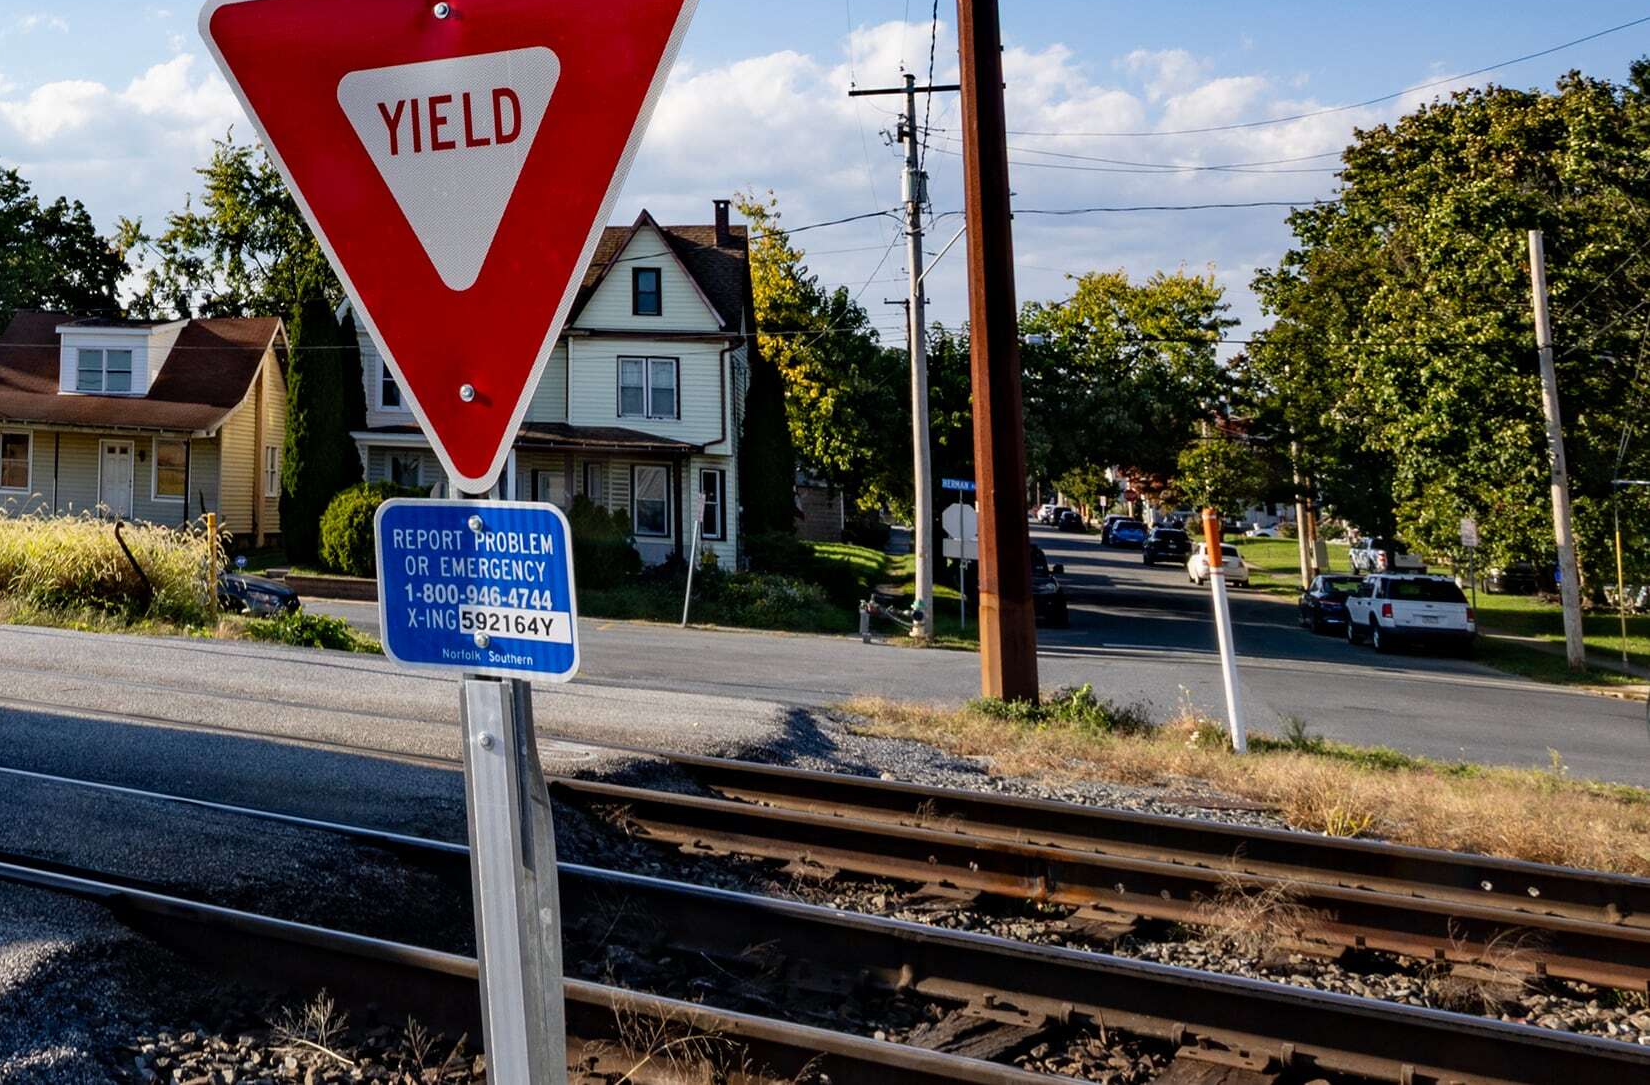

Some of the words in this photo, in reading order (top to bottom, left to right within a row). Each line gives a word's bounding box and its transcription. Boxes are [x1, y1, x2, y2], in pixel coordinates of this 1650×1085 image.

[377, 87, 522, 156] YIELD
[394, 529, 462, 550] REPORT
[474, 531, 554, 555] PROBLEM
[405, 555, 429, 576] OR
[441, 557, 545, 582] EMERGENCY
[405, 583, 552, 610] 1-800-946-4744
[408, 608, 456, 629] X-ING
[461, 611, 554, 636] 592164Y
[442, 648, 482, 661] Norfolk
[488, 650, 534, 666] Southern
